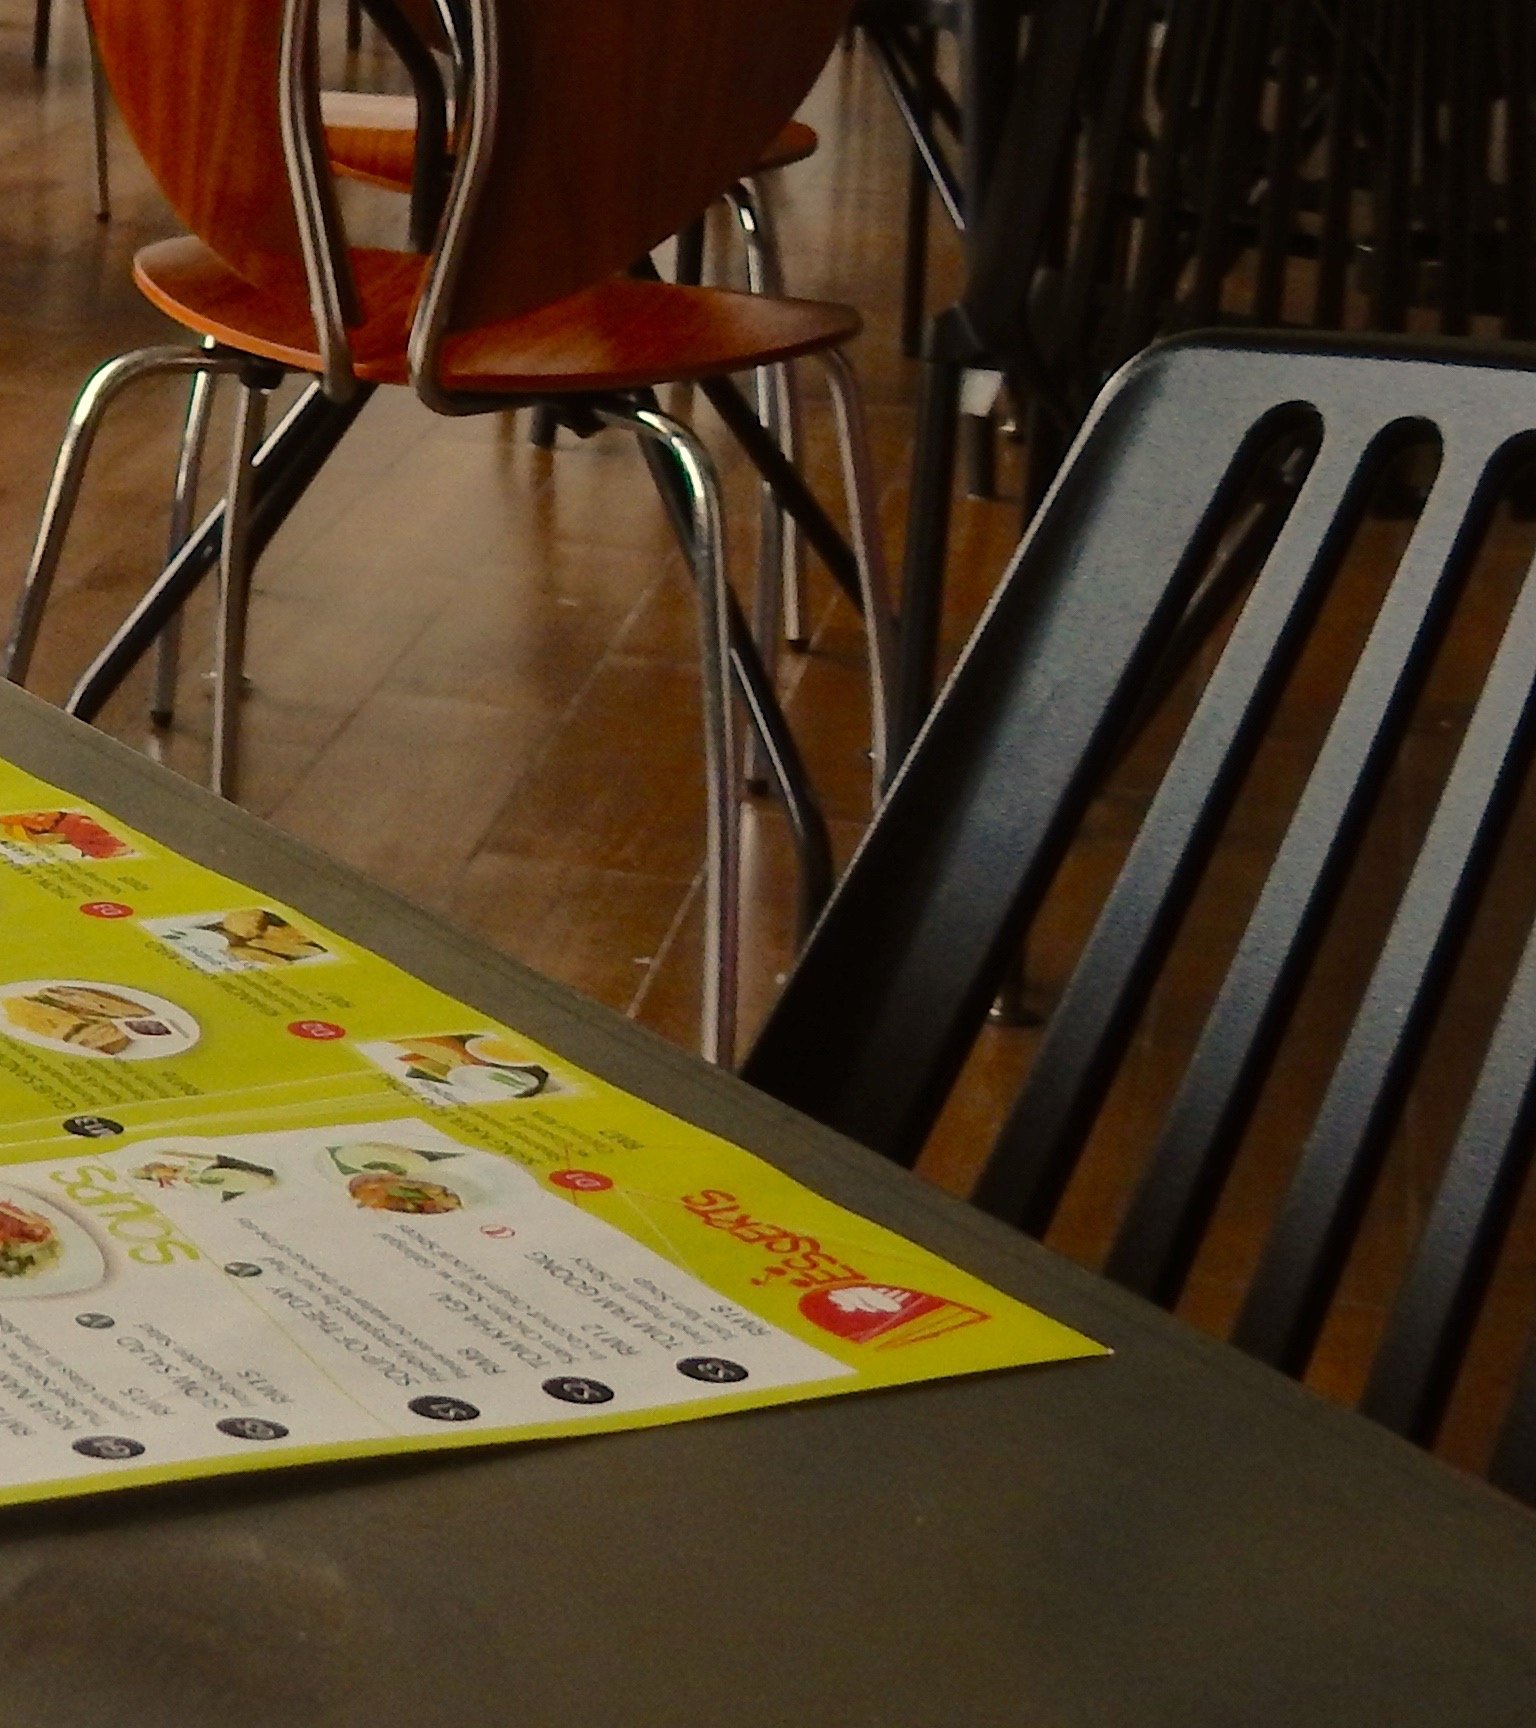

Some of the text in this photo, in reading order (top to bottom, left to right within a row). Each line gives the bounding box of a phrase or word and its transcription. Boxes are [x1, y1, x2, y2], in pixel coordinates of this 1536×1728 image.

[50, 1164, 200, 1266] SOUPS
[519, 1251, 688, 1348] TOM YAM GOONG
[455, 1313, 513, 1339] KHA
[355, 1352, 426, 1386] SOUP
[494, 1339, 558, 1368] TOM
